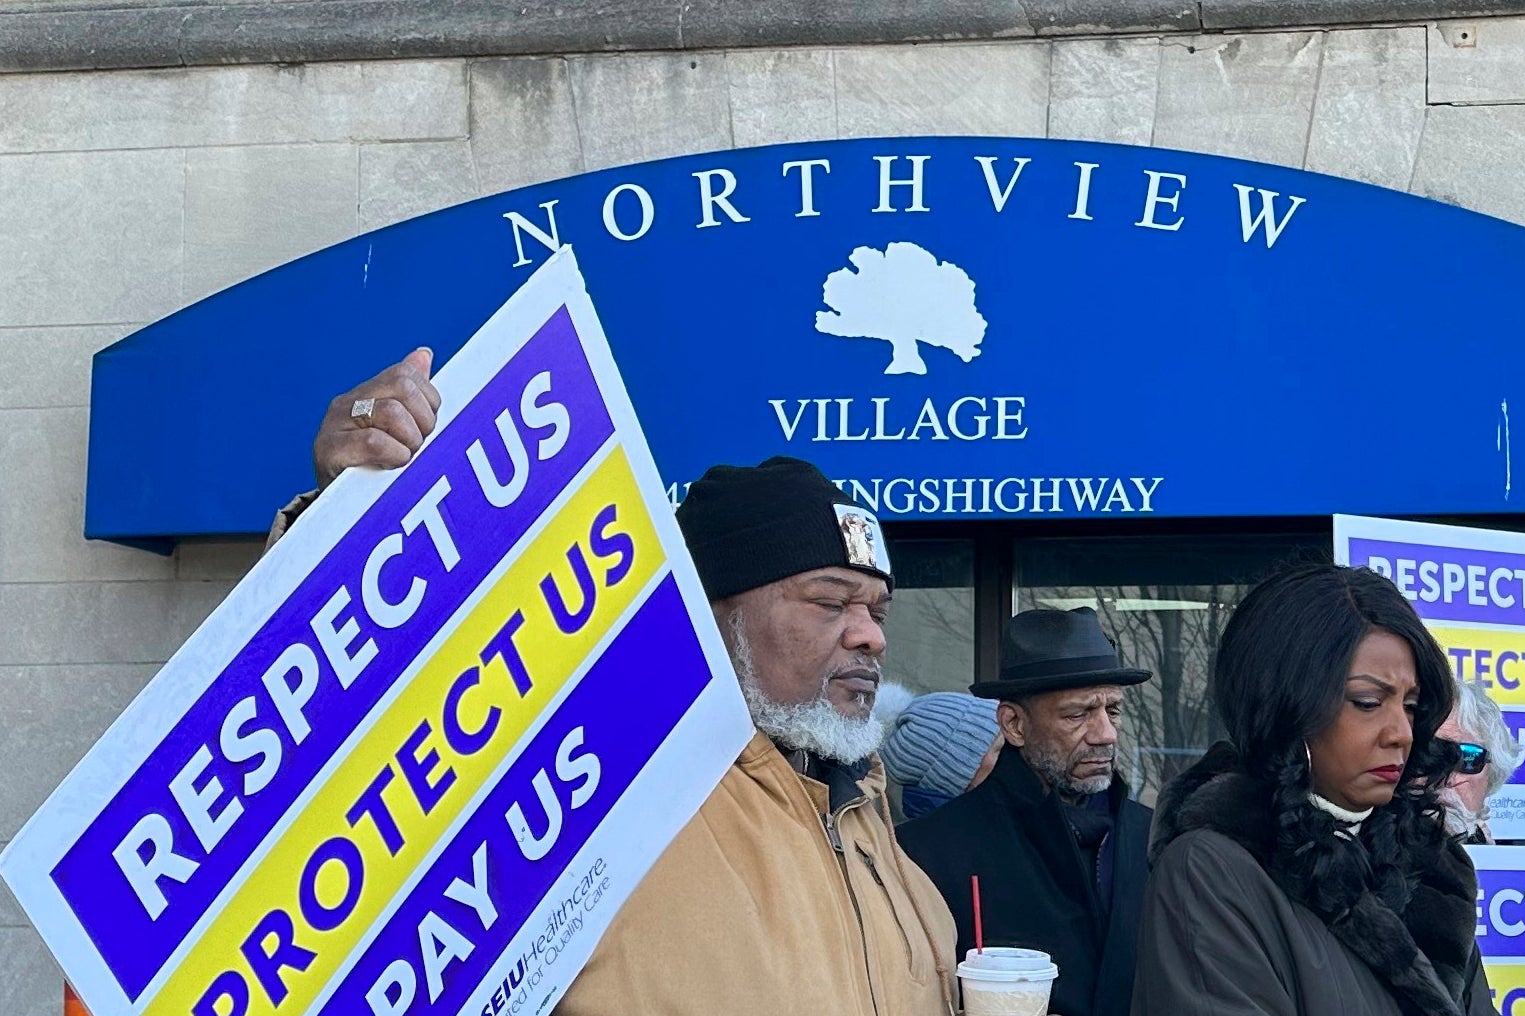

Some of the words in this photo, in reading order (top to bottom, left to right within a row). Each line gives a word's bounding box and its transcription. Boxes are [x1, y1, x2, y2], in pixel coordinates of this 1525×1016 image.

[503, 155, 1307, 268] NORTHVIEW
[768, 397, 1028, 442] VILLAGE
[540, 504, 636, 636] US
[112, 475, 462, 922] RESPECT
[466, 370, 572, 508] US
[506, 726, 602, 863] US
[526, 966, 545, 988] for
[545, 916, 584, 965] Quality
[584, 876, 610, 913] Care
